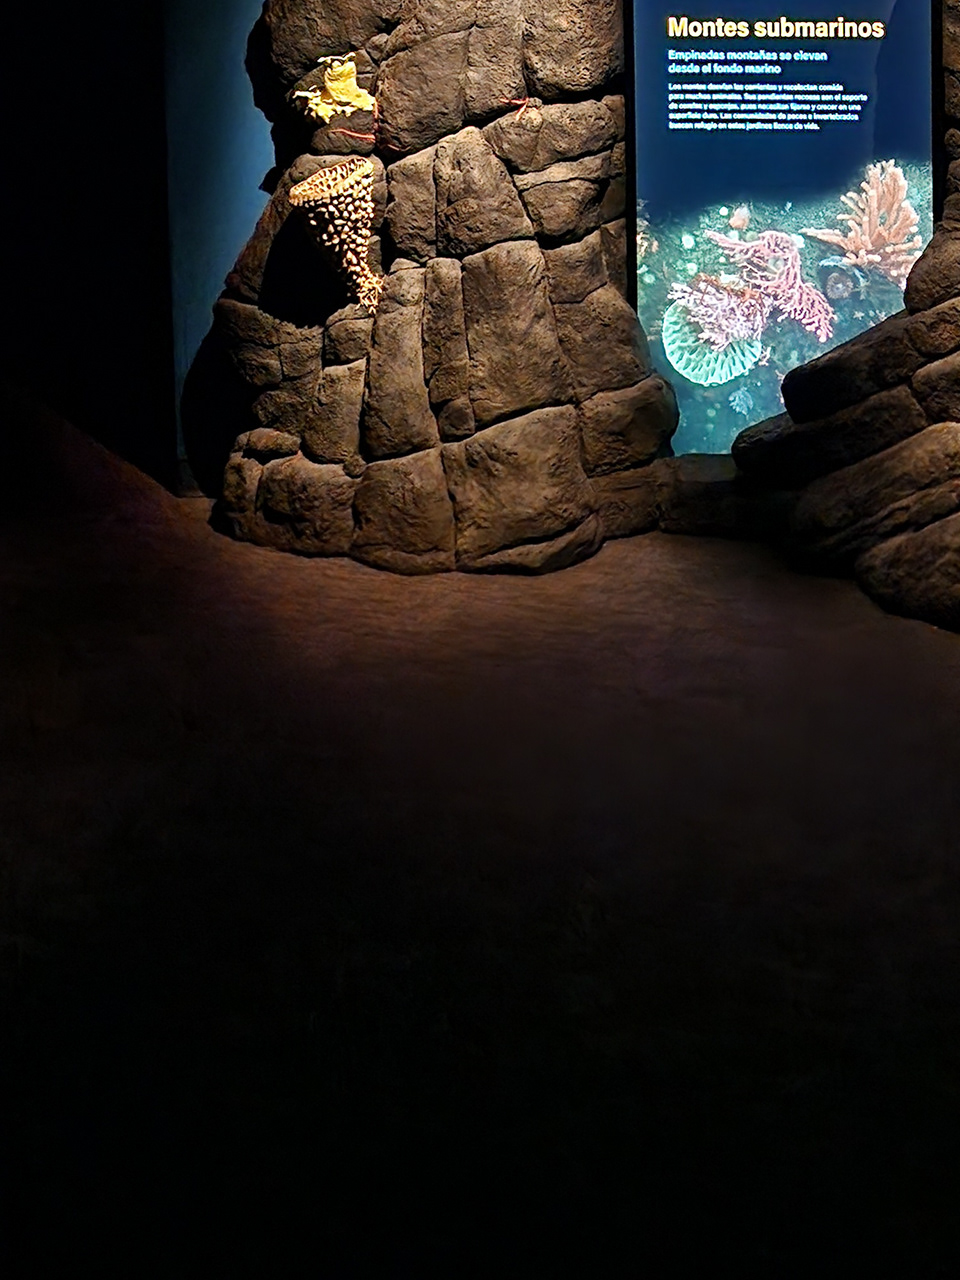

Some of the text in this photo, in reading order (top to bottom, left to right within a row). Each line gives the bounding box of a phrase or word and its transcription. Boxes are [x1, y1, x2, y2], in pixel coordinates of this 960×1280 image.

[668, 17, 885, 37] Montes submarinos
[669, 50, 827, 61] Empinadas montañas se elevan
[668, 63, 699, 73] desde
[713, 63, 743, 73] fondo
[745, 64, 781, 73] marino
[669, 83, 681, 91] Los
[783, 83, 817, 91] recolectan
[819, 84, 843, 92] comida
[669, 94, 684, 102] para
[685, 92, 711, 100] muchos
[842, 94, 867, 102] soporte
[816, 103, 839, 111] crecer
[787, 113, 807, 121] peces
[814, 113, 858, 121] invertebrados
[669, 121, 695, 129] buscan
[746, 122, 772, 130] jardines
